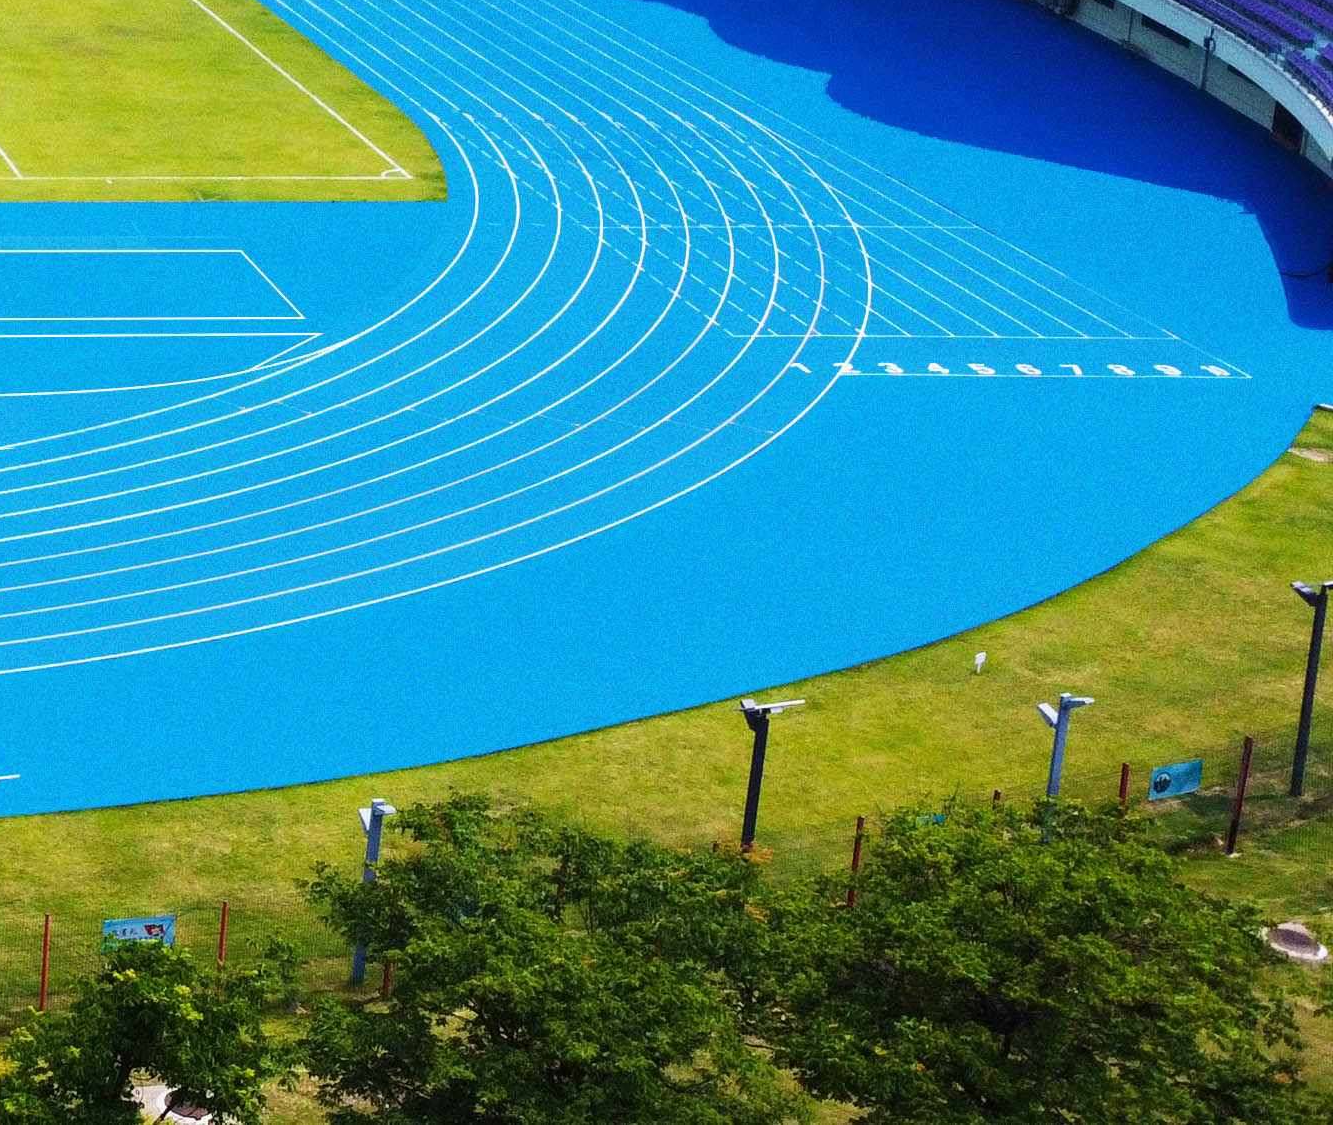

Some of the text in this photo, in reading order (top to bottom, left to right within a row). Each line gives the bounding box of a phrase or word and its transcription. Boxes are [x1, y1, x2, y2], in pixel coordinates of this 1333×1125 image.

[877, 362, 904, 374] 3
[966, 363, 996, 375] 5
[1059, 364, 1083, 376] 7
